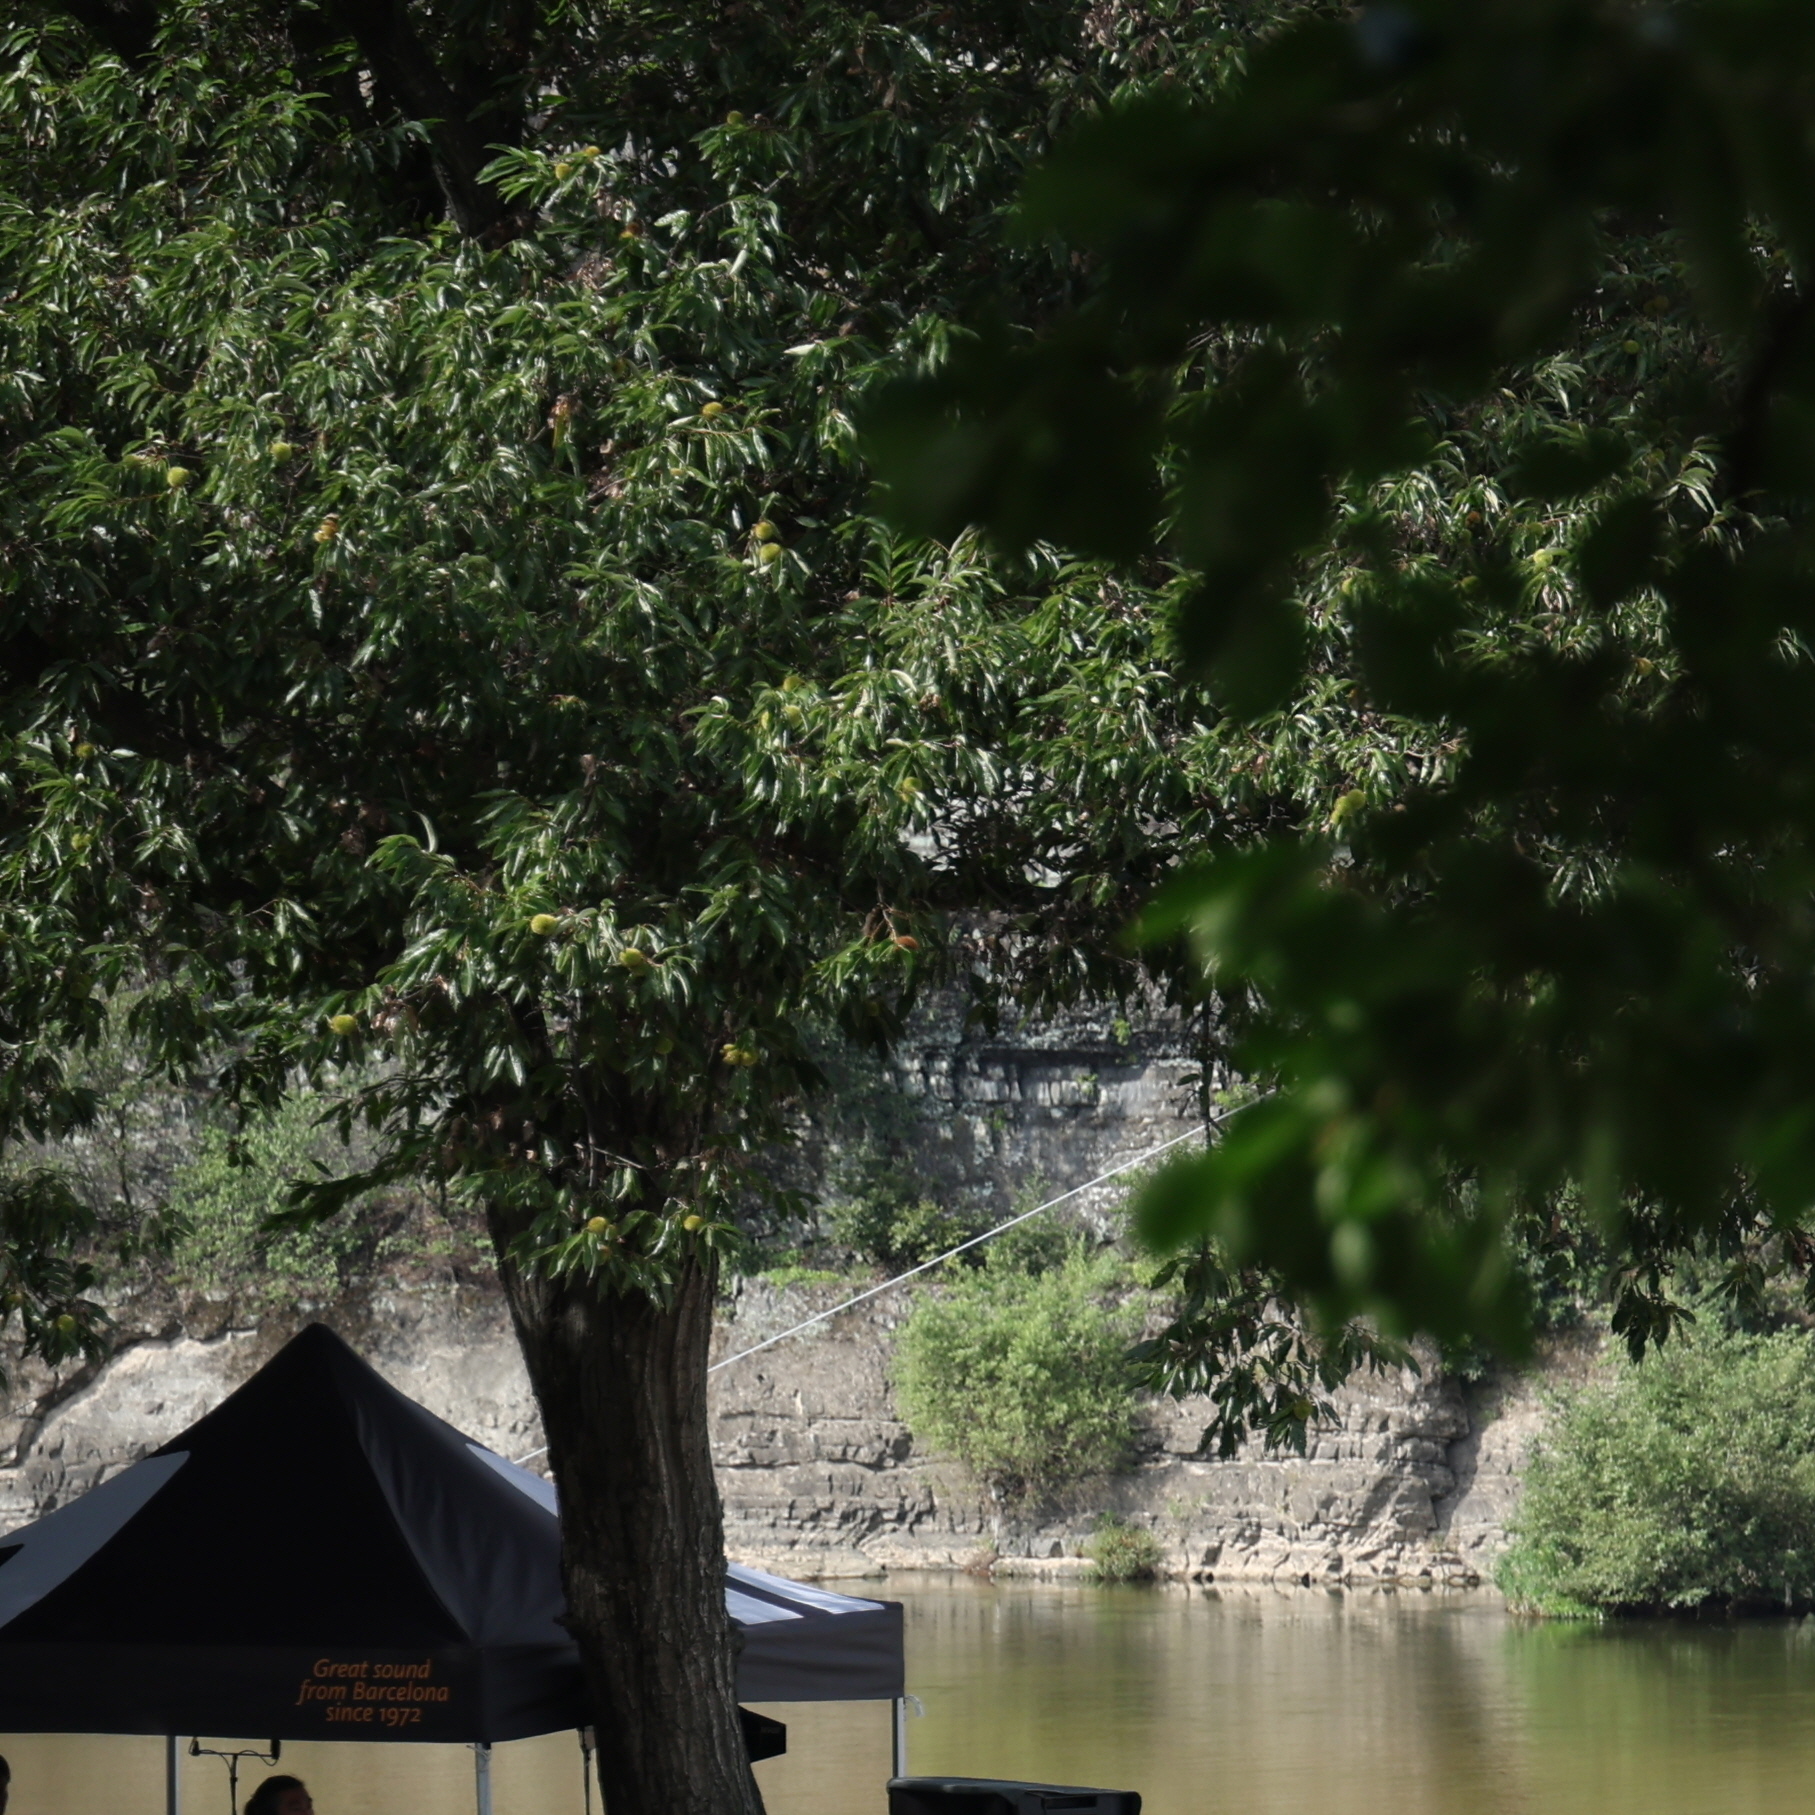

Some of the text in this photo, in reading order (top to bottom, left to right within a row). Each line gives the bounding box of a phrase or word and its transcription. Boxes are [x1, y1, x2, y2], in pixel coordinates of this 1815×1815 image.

[313, 1658, 431, 1679] Great sound
[295, 1679, 450, 1705] from Barcelona
[326, 1702, 422, 1726] since 1972
